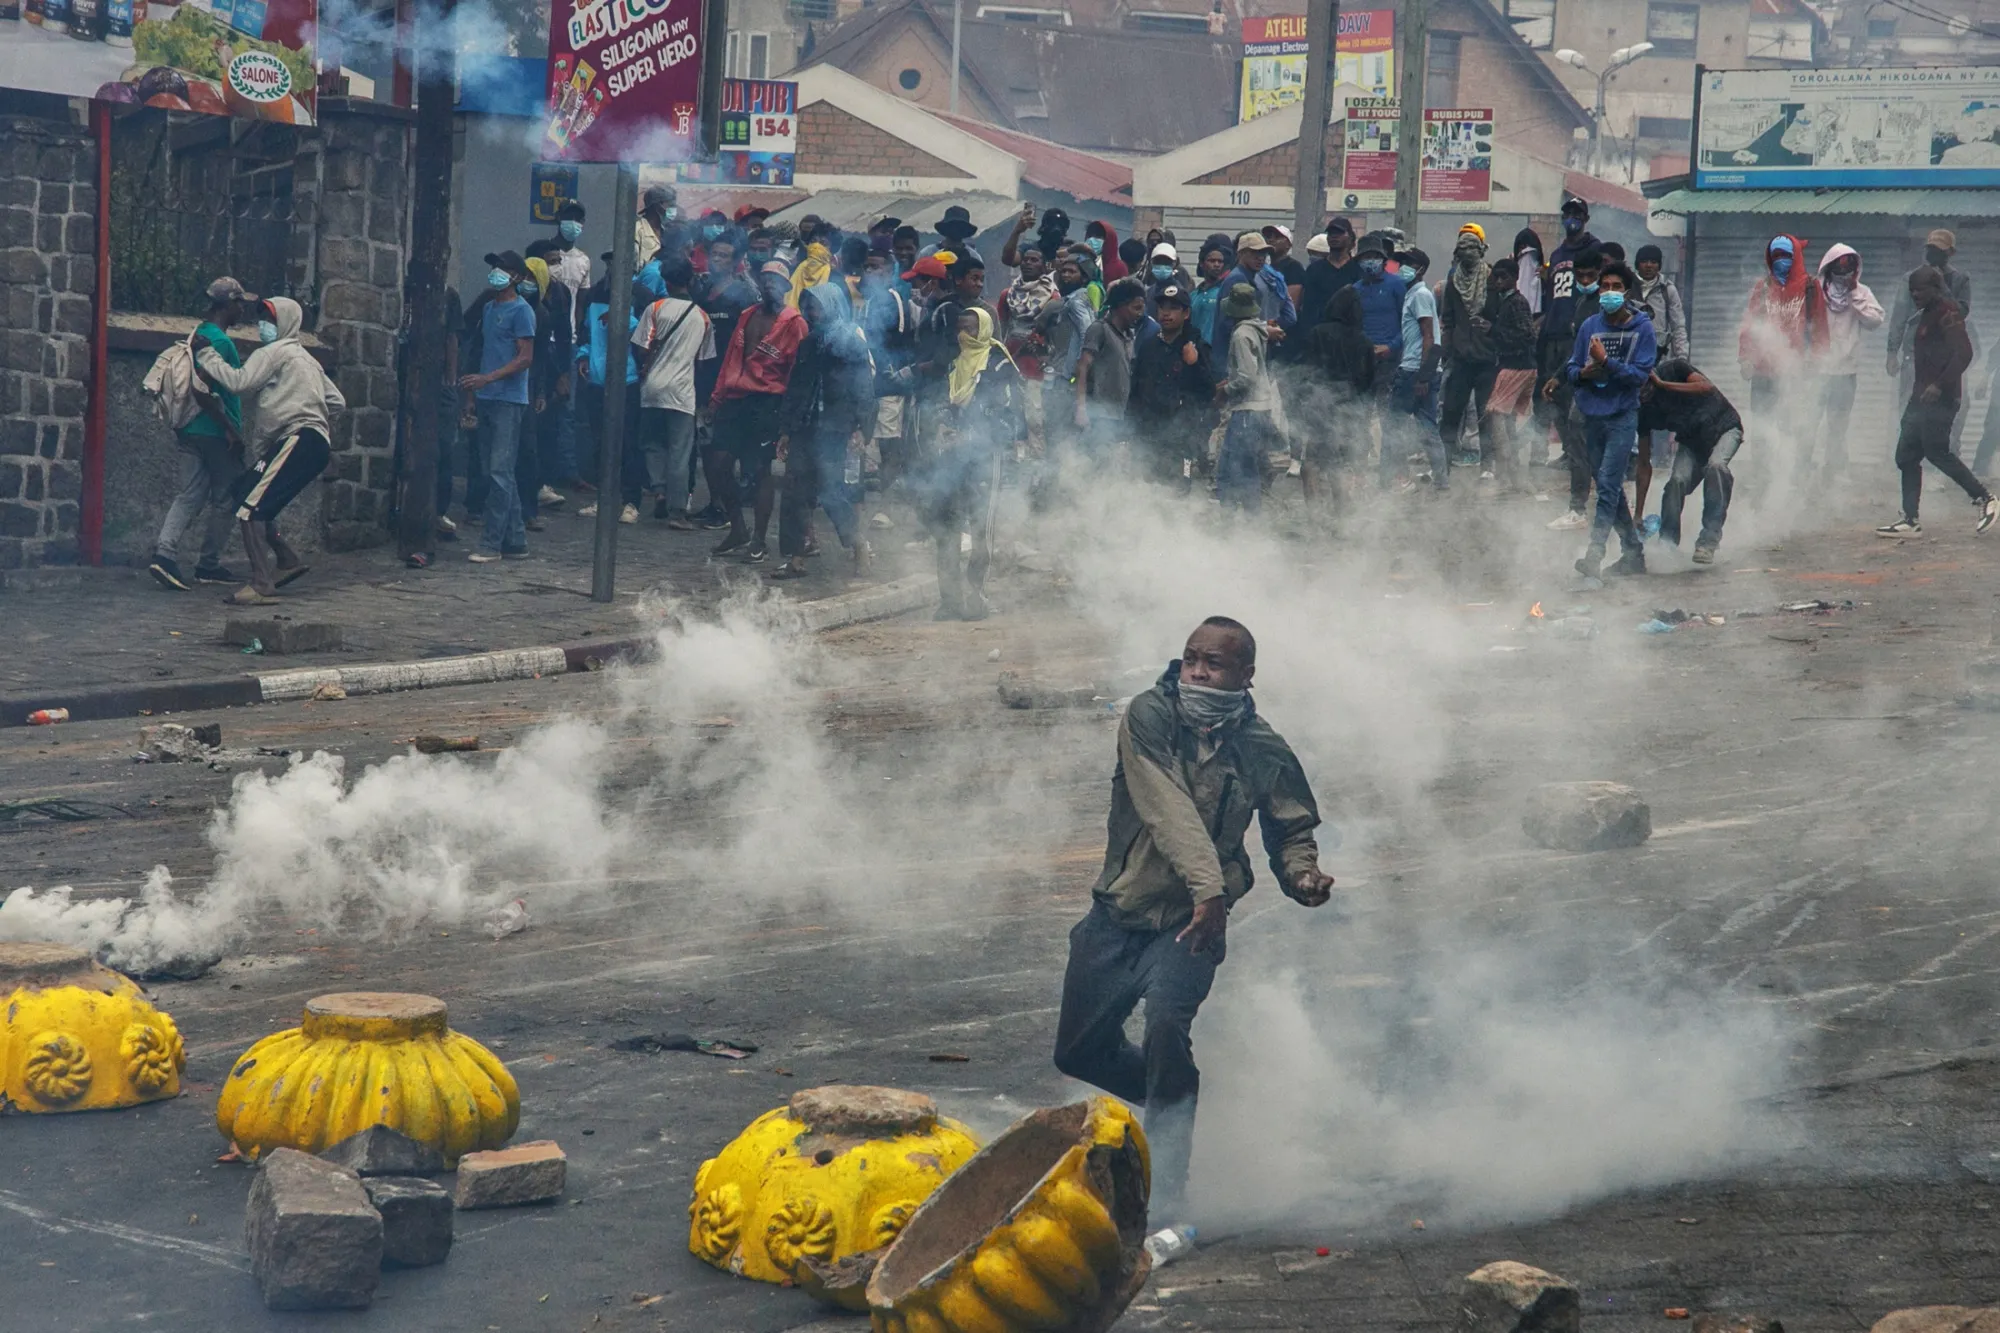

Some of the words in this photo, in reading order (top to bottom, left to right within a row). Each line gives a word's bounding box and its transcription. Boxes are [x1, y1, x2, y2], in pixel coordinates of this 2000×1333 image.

[600, 19, 669, 71] SILIGOMA
[1245, 42, 1281, 56] Dépannage
[608, 56, 656, 97] SUPER
[657, 33, 697, 71] HERO
[241, 66, 279, 84] SALONE
[1792, 73, 1872, 83] TOROLALANA
[1880, 72, 1952, 81] HIKOLOANA
[1960, 72, 1975, 80] NY
[749, 83, 790, 114] PUB
[1432, 110, 1462, 119] RUBIS
[1463, 110, 1484, 119] PUB
[675, 117, 689, 135] JB
[756, 118, 790, 137] 154
[890, 179, 910, 187] 111
[1230, 190, 1250, 205] 110
[1553, 270, 1574, 299] 22
